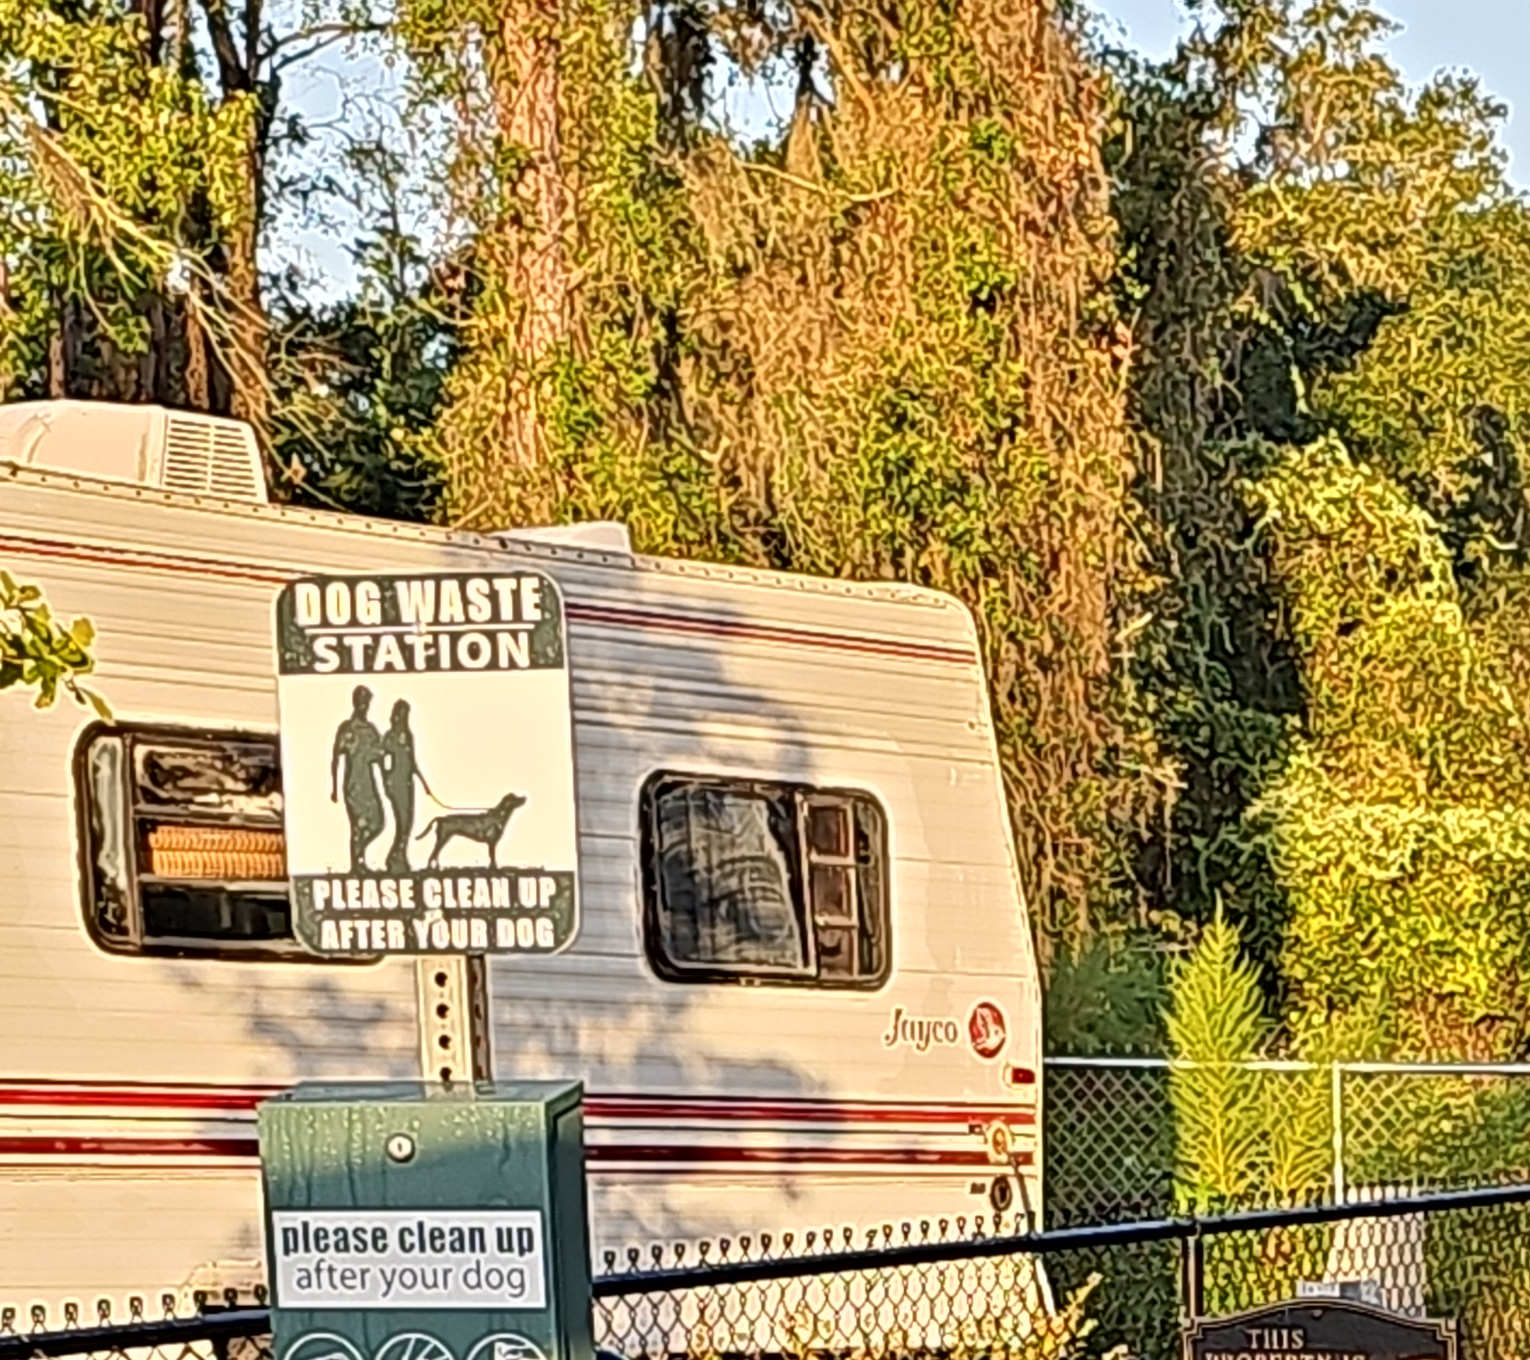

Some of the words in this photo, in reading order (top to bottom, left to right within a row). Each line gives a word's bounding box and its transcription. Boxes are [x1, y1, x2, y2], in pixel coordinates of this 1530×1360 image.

[295, 580, 381, 626] DOG
[395, 577, 542, 623] WASTE
[312, 632, 530, 673] STATION
[313, 879, 415, 910] PLEASE
[423, 877, 510, 909] CLEAN
[518, 877, 557, 908] UP
[321, 919, 406, 949] AFTER
[412, 917, 488, 949] YOUR
[496, 918, 555, 948] DOG
[885, 1008, 958, 1052] Jayco
[282, 1221, 388, 1256] please
[398, 1221, 487, 1253] clean
[496, 1227, 535, 1257] up
[296, 1259, 370, 1290] after
[379, 1267, 452, 1298] your
[462, 1259, 526, 1298] dog
[1246, 1329, 1305, 1349] THIS
